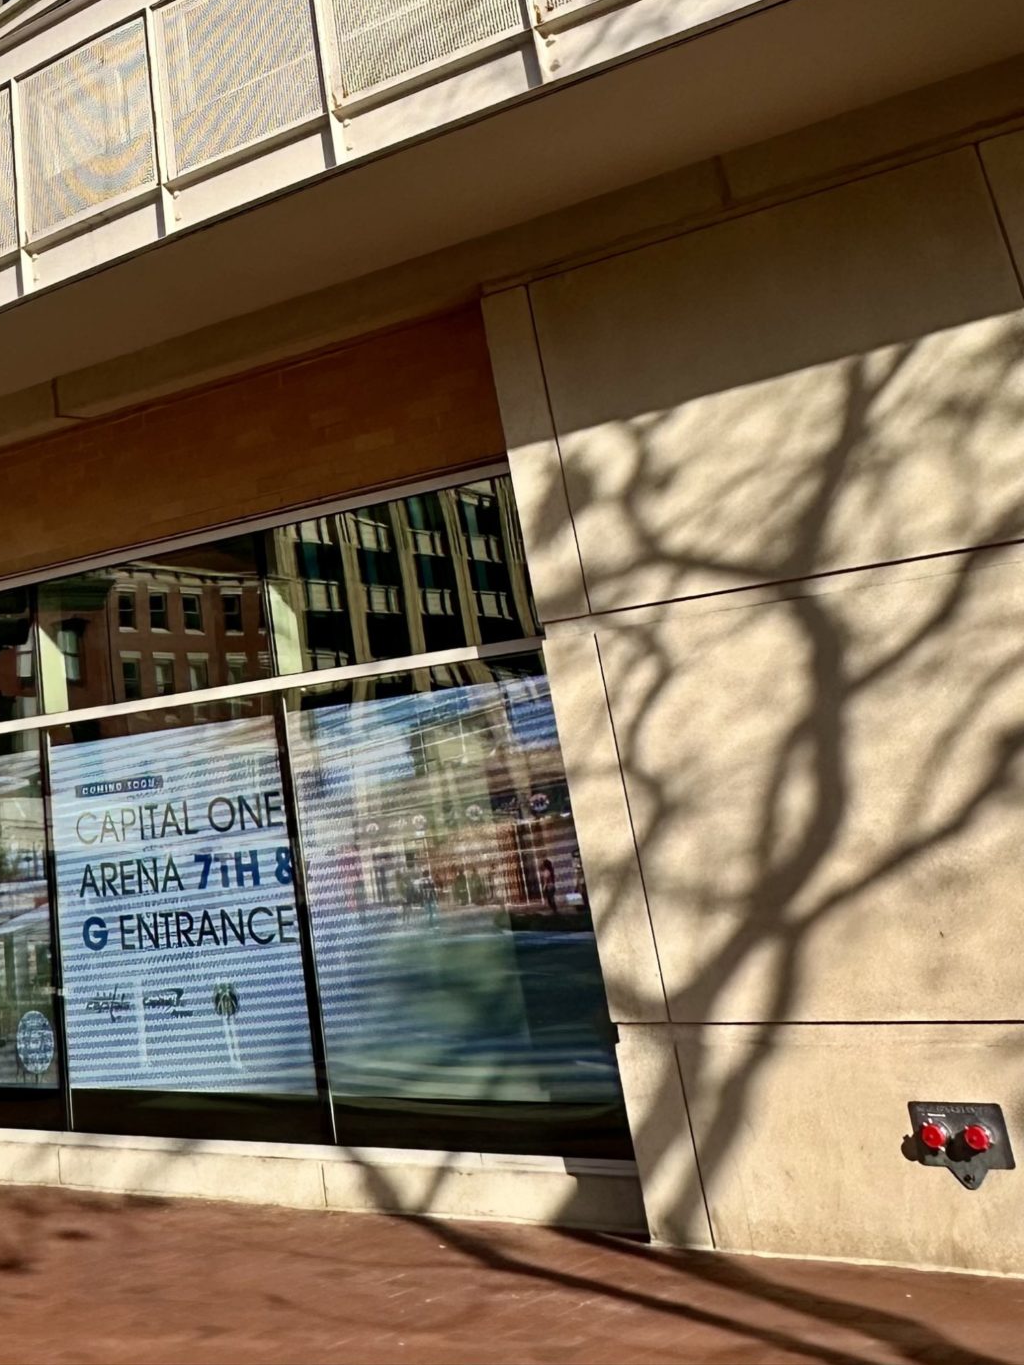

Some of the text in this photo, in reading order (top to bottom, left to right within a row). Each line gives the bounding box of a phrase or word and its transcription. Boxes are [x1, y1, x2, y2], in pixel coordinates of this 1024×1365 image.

[76, 791, 283, 845] CAPITAL ONE
[79, 846, 293, 898] ARENA 7TH &
[83, 905, 298, 951] G ENTRANCE
